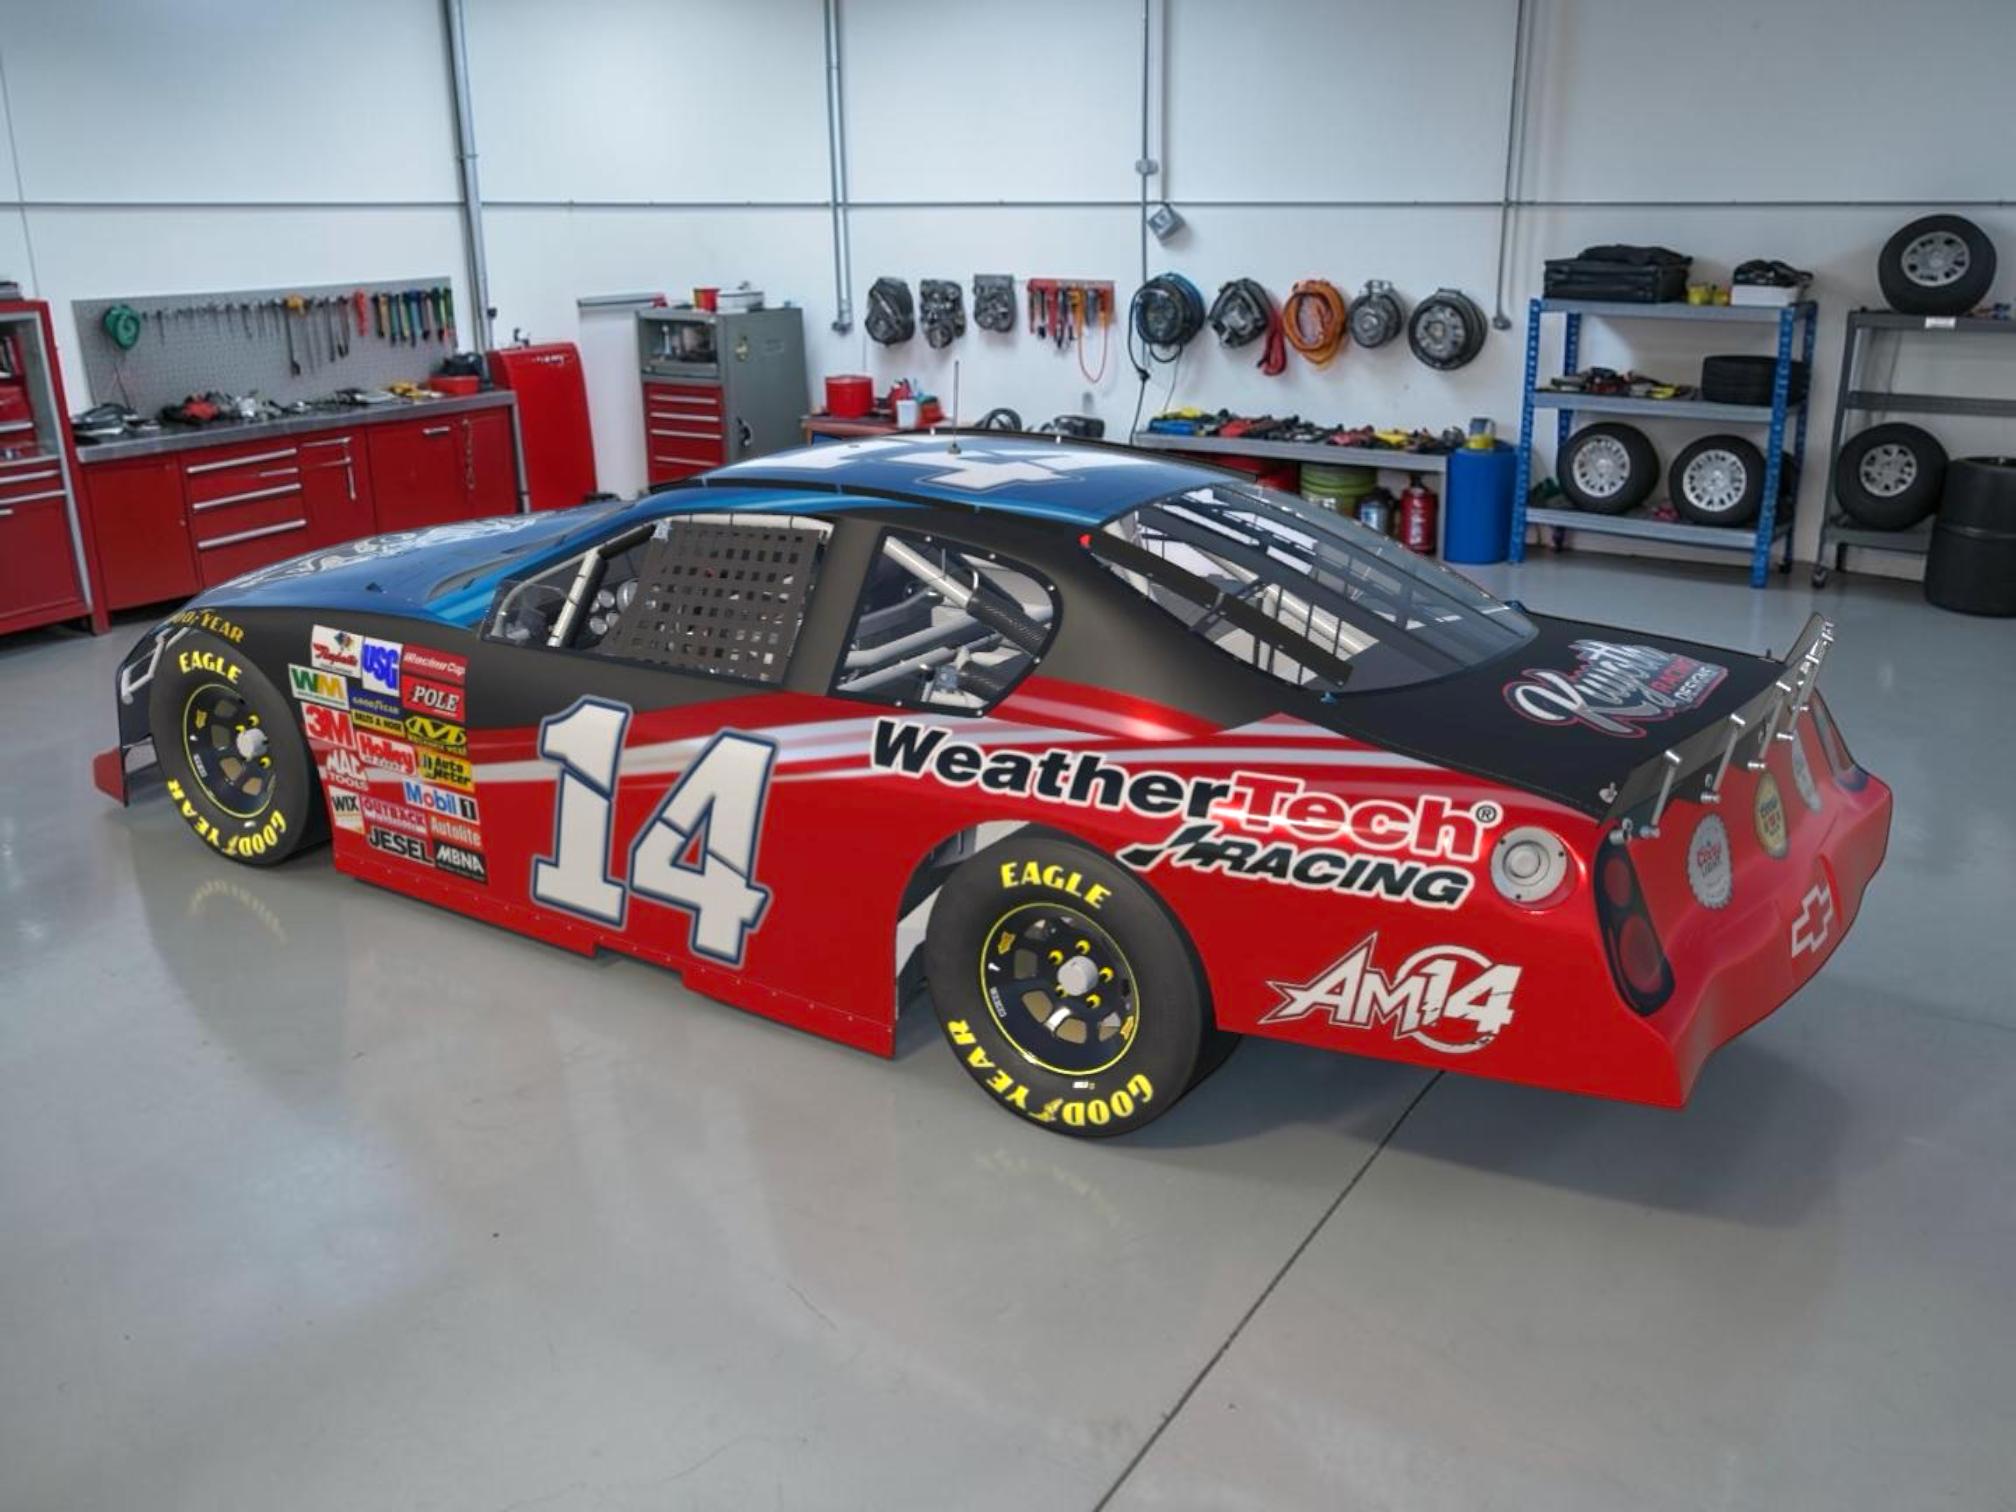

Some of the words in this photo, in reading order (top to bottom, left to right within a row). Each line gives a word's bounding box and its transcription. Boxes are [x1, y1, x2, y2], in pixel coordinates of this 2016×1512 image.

[179, 650, 242, 685] EAGLE
[291, 667, 345, 700] WM
[363, 644, 399, 690] USG
[412, 685, 460, 712] POLE
[305, 706, 353, 747] 3M
[435, 756, 463, 773] Auto
[435, 766, 471, 785] Meter
[332, 795, 359, 812] WIX
[405, 782, 457, 815] Mobil
[167, 779, 286, 856] GOODYEAR
[531, 695, 777, 967] 14
[369, 827, 434, 863] JESEL
[436, 845, 485, 874] MBNA
[1001, 861, 1112, 909] EAGLE
[1208, 838, 1472, 907] RACING
[1259, 931, 1523, 1052] AM14
[947, 1019, 1154, 1127] GOODYEAR
